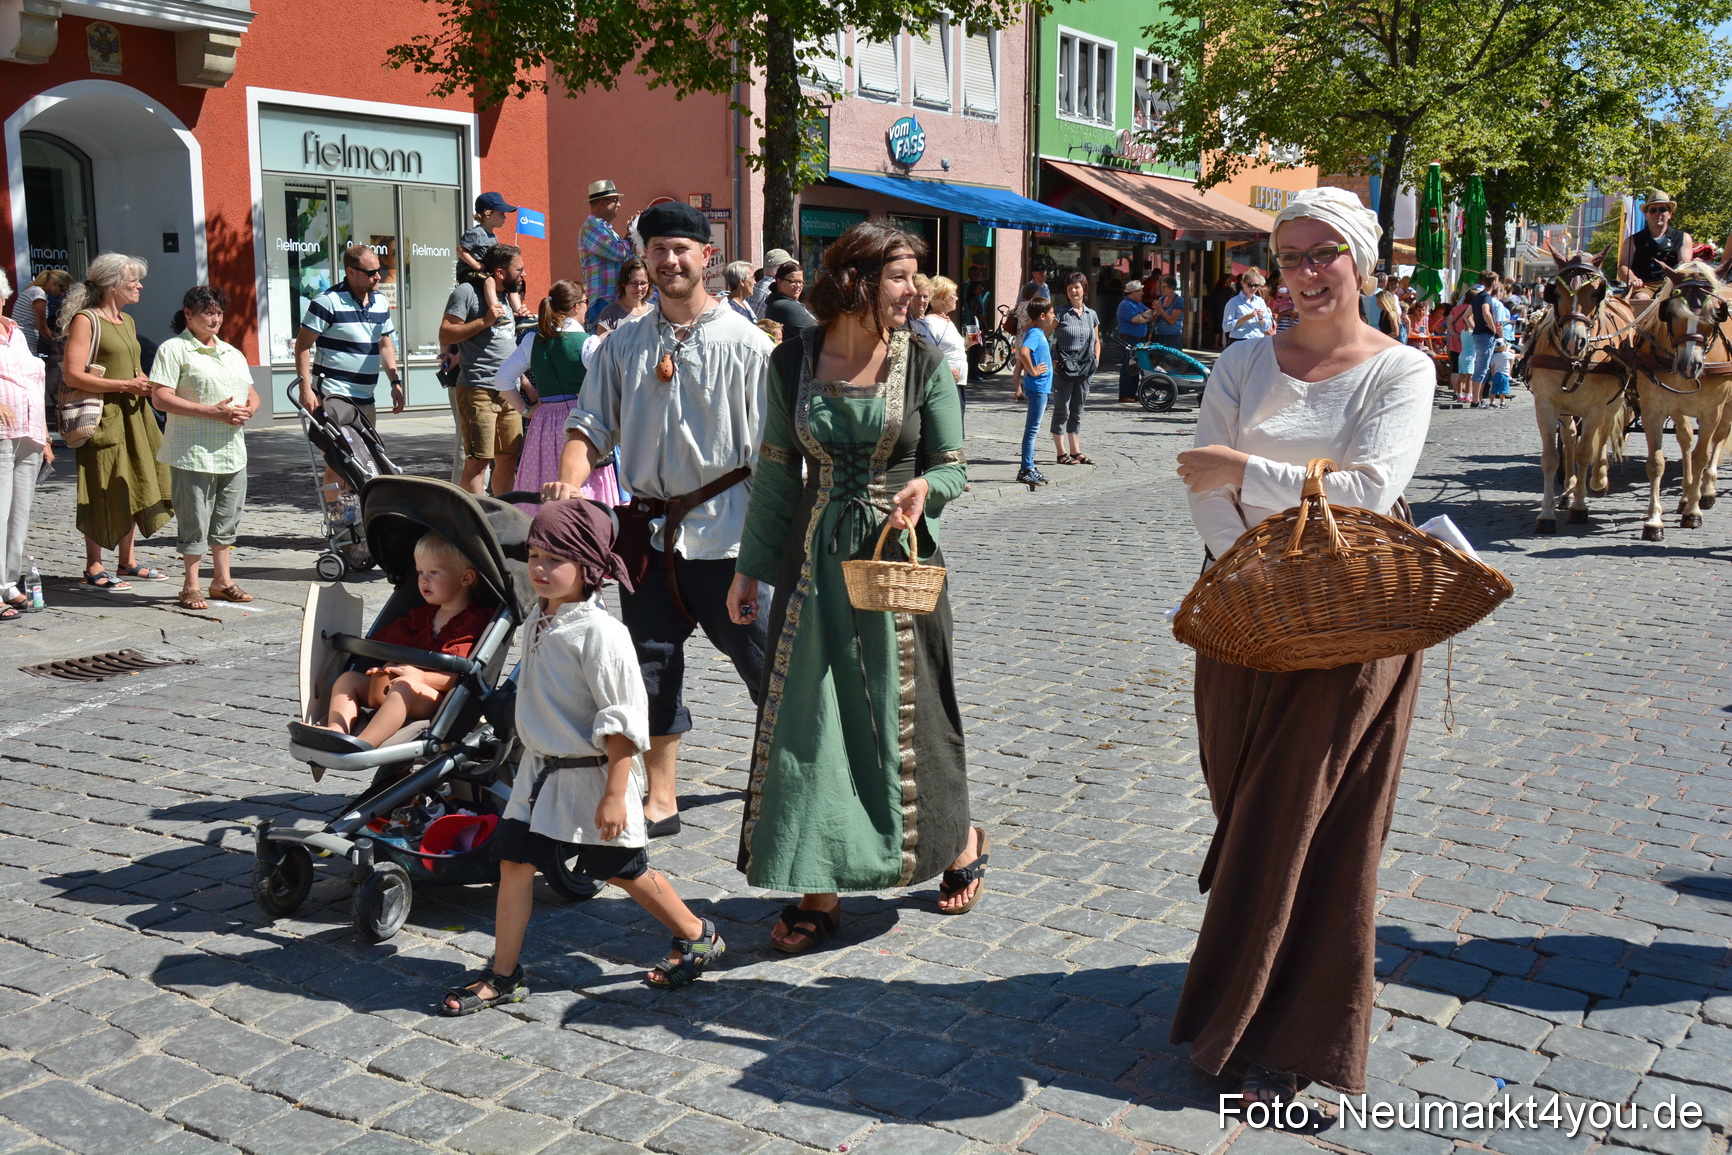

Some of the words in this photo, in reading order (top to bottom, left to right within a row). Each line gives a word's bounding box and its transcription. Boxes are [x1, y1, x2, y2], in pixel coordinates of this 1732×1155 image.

[889, 121, 910, 141] vom
[303, 130, 423, 175] fielmann
[895, 132, 925, 160] FASS
[1255, 186, 1282, 211] LEDER
[801, 216, 836, 231] Spirituosen
[30, 244, 68, 259] lmann
[276, 237, 320, 253] fielmann
[412, 243, 450, 257] fielmann
